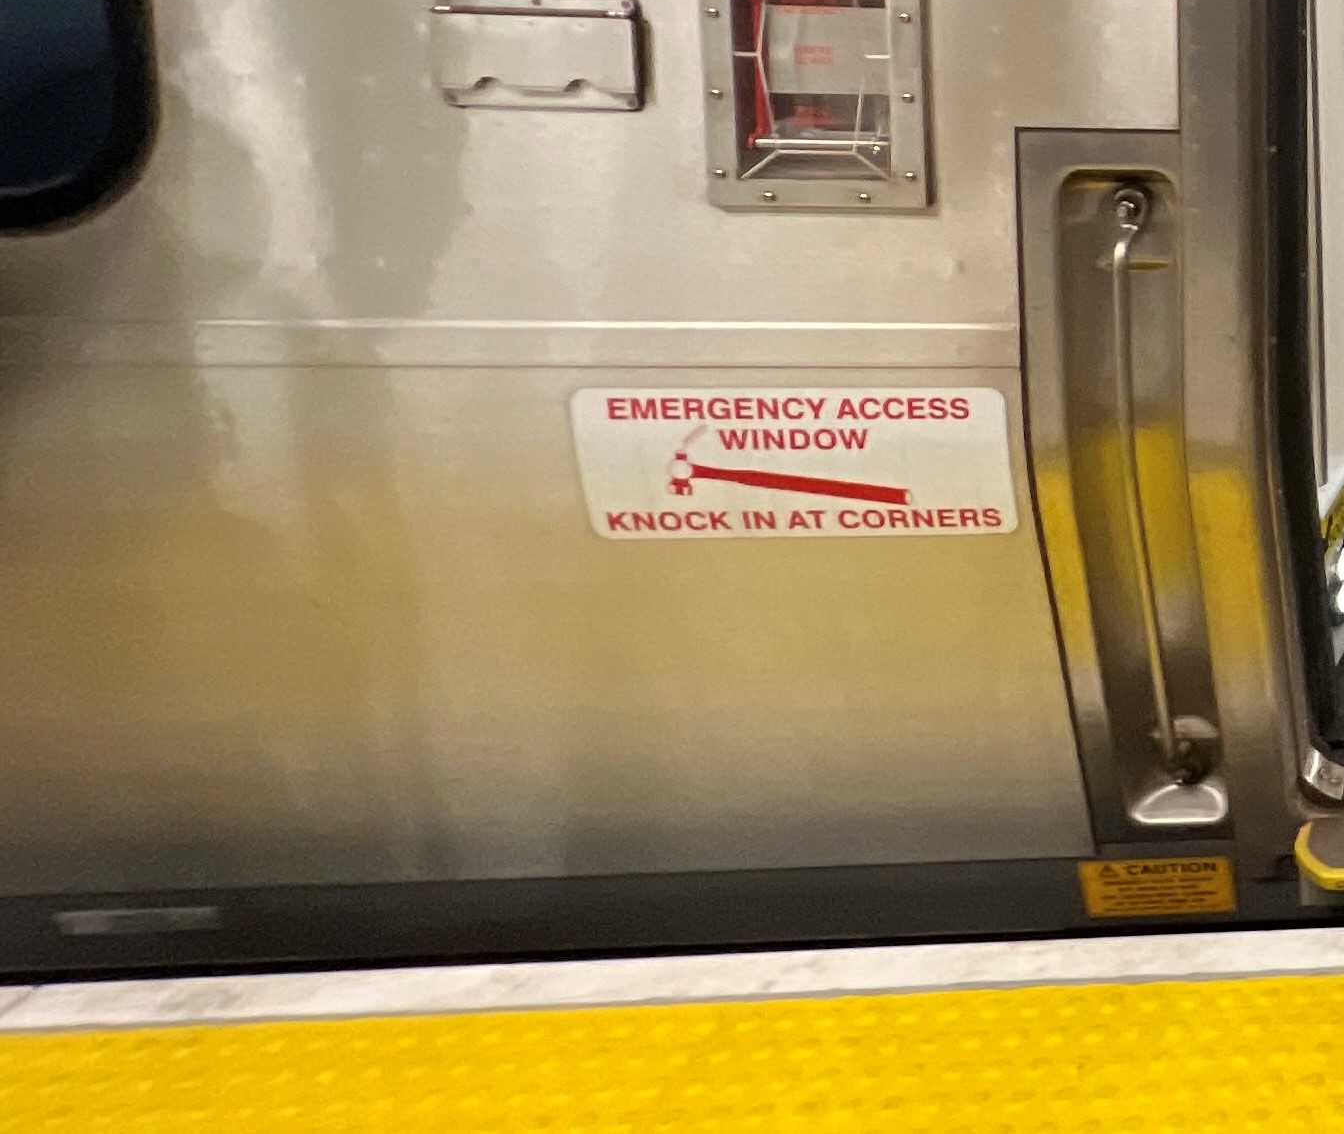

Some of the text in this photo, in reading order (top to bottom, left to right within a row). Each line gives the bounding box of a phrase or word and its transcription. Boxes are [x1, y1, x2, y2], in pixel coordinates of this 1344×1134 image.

[606, 397, 970, 421] EMERGENCY ACCESS
[718, 428, 869, 451] WINDOW
[606, 507, 1002, 531] KNOCK IN AT CORNERS
[1126, 862, 1217, 876] CAUTION
